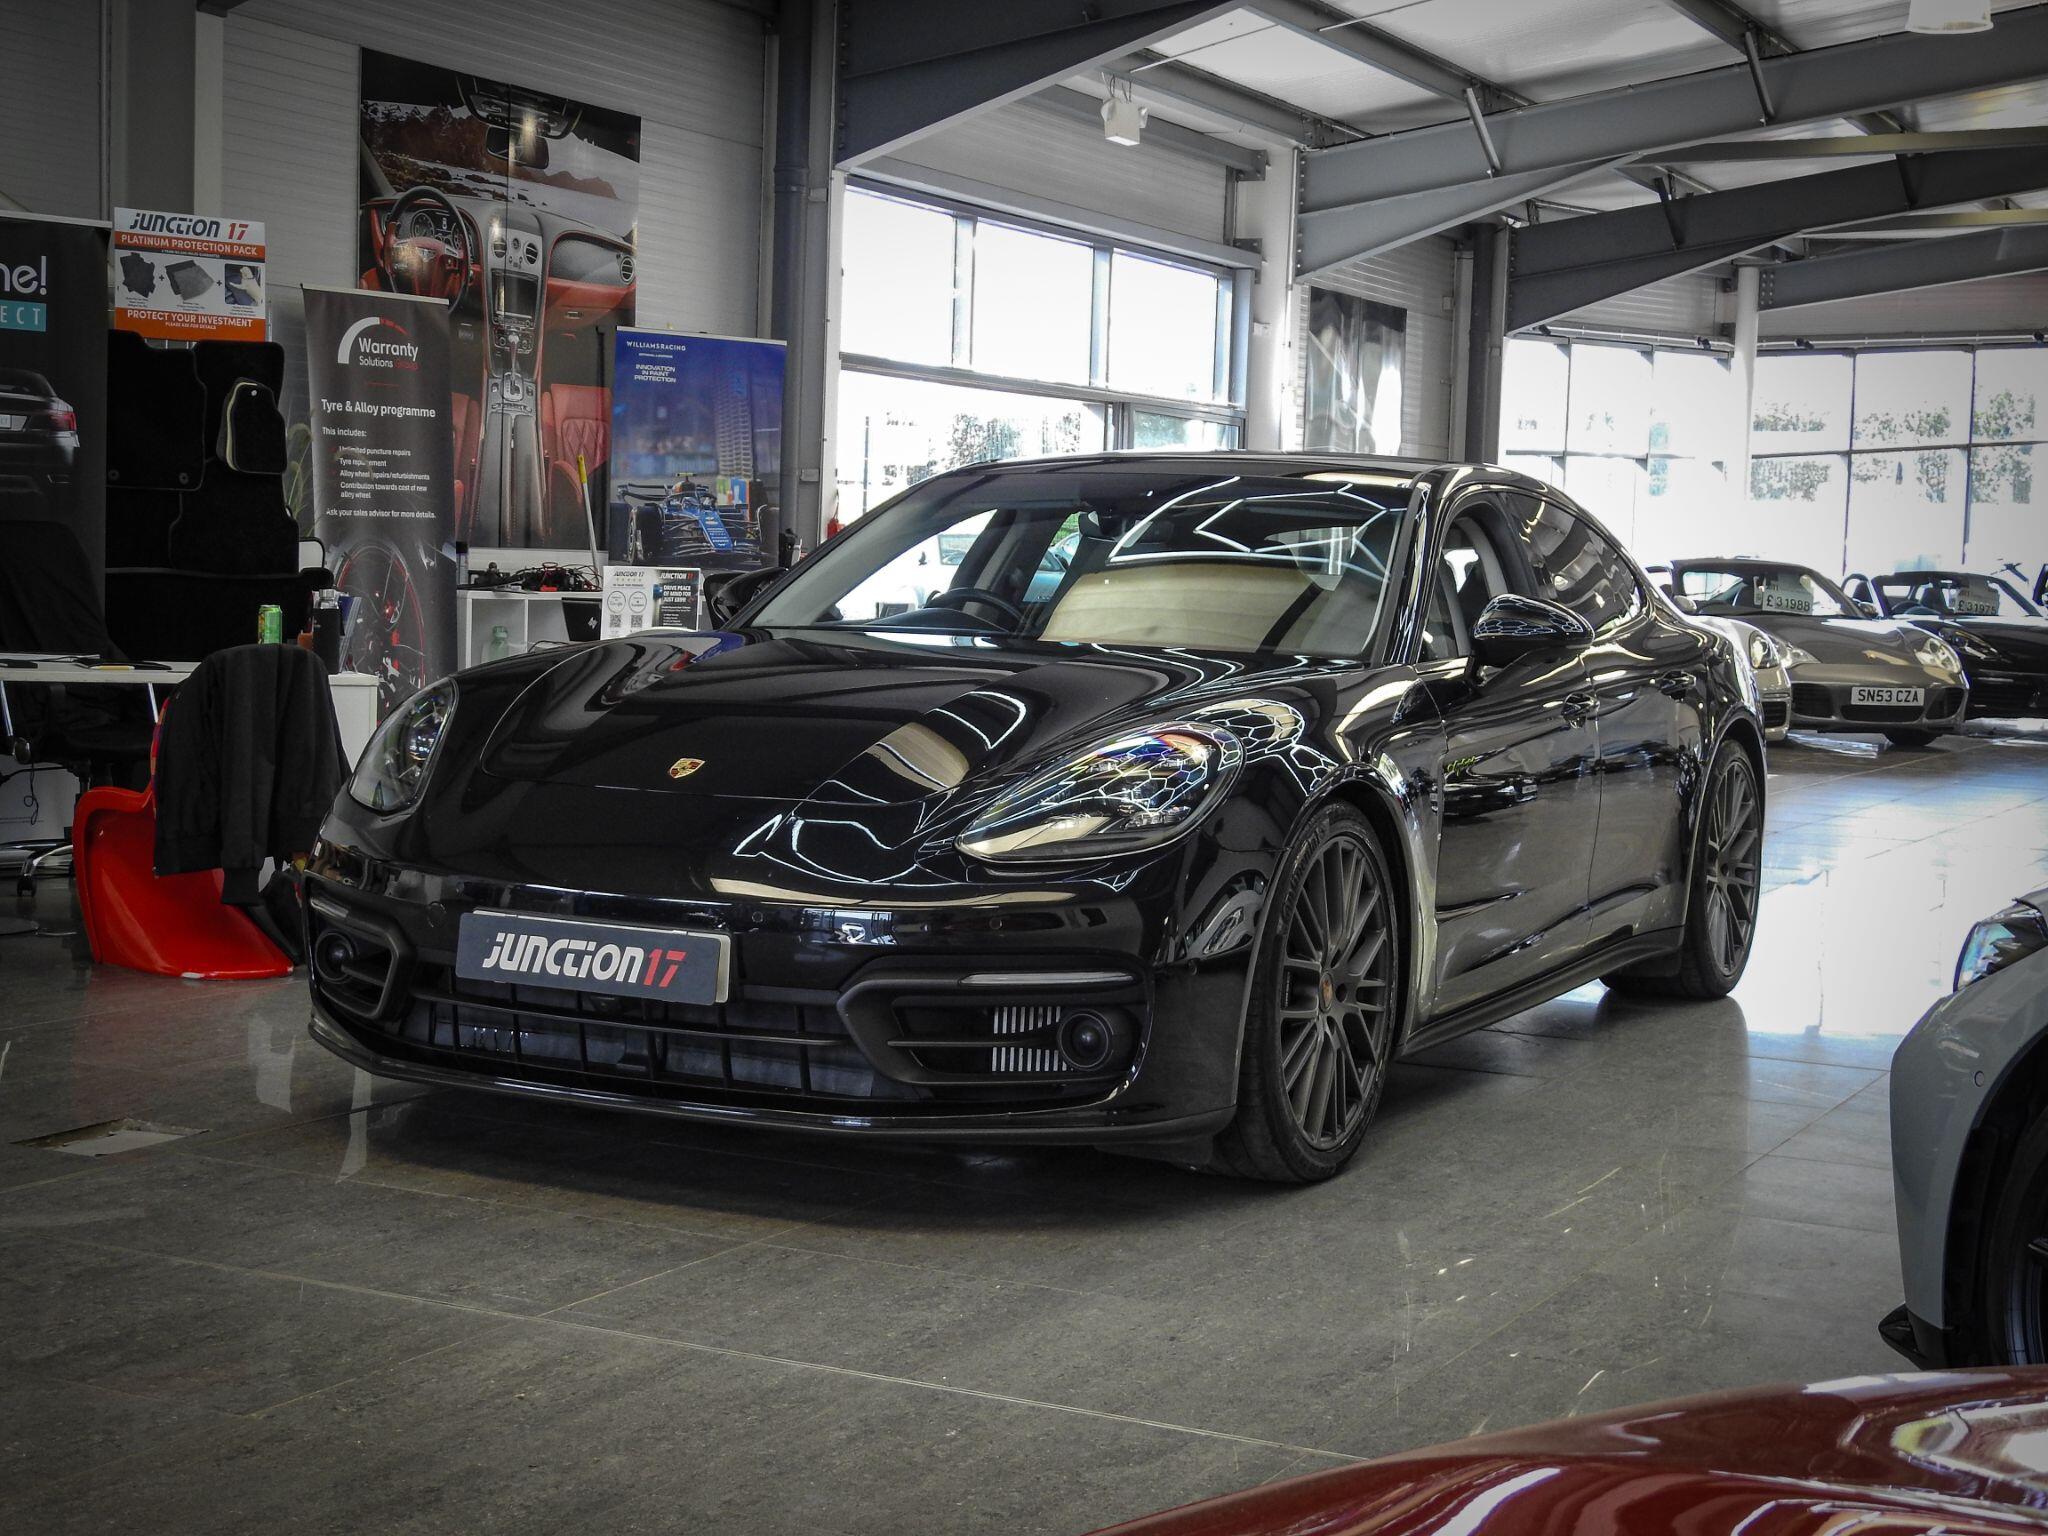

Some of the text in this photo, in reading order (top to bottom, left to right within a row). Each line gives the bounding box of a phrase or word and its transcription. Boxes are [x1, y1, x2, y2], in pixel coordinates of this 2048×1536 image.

[228, 222, 249, 240] 17
[121, 234, 170, 248] PLATINUM
[172, 239, 231, 253] PROTECTION
[234, 246, 257, 256] PACK
[127, 310, 253, 327] PROTECT YOUR INVESTMENT
[358, 337, 418, 361] Warranty
[360, 356, 393, 368] Solutions
[321, 399, 436, 417] Tyre & Alloy programme
[322, 427, 336, 435] This
[1767, 595, 1810, 612] £31988
[1858, 689, 1919, 702] SN53 CZA
